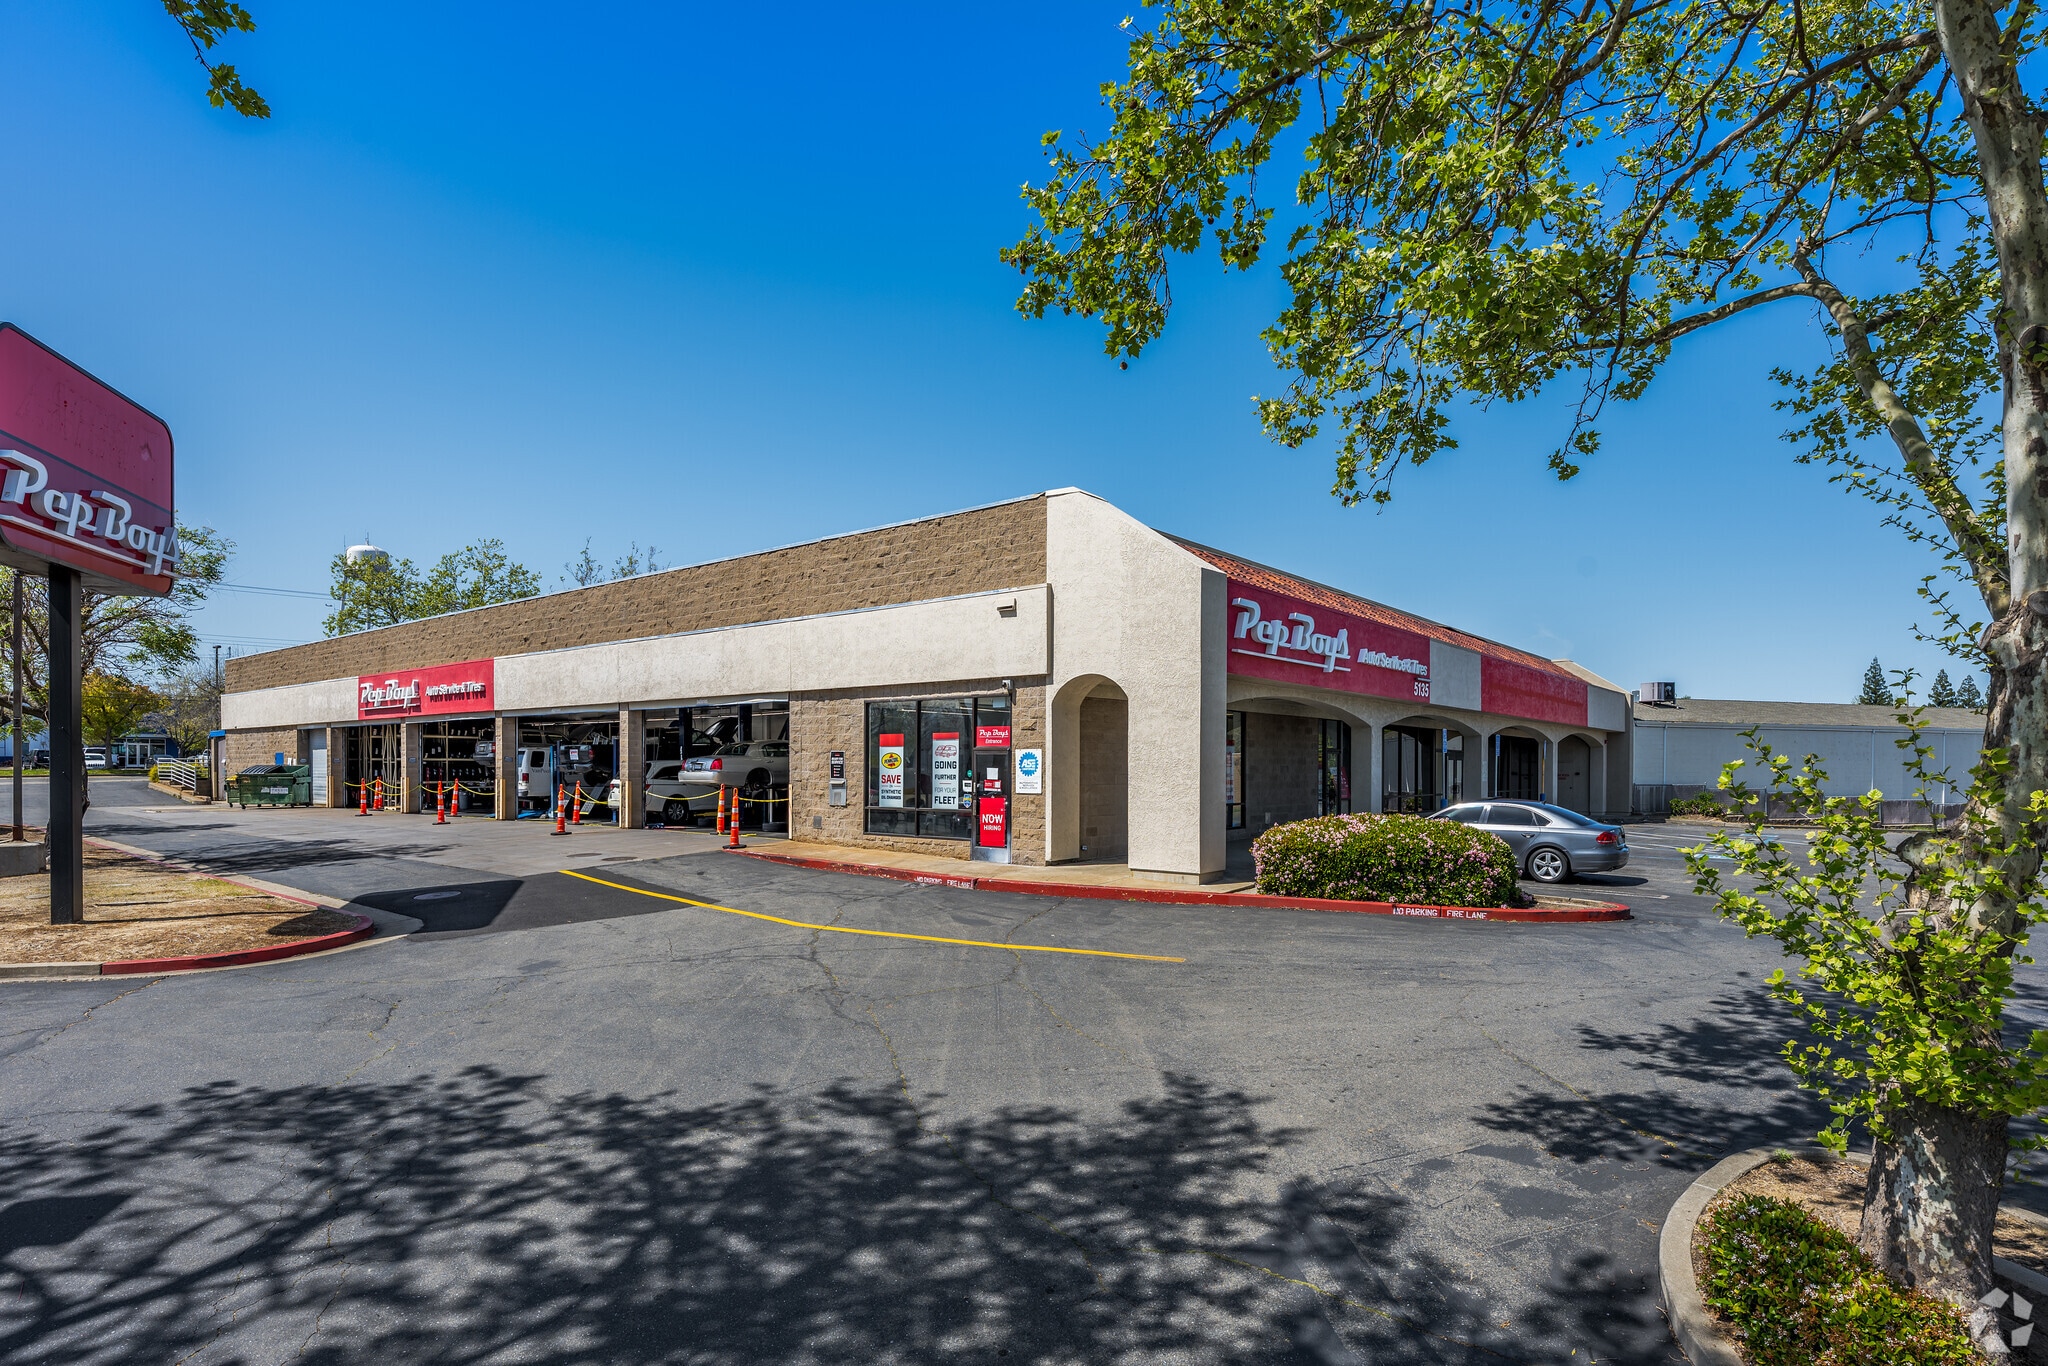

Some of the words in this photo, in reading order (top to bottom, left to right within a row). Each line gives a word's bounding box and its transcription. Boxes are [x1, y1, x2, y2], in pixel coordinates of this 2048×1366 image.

[0, 450, 97, 537] Pep
[90, 490, 183, 576] Boys
[1231, 597, 1291, 655] Pep
[1288, 612, 1351, 673] Boys
[1357, 648, 1380, 667] Auto
[1379, 652, 1406, 672] Service
[1411, 660, 1428, 676] Tires
[360, 682, 386, 707] Pep
[384, 679, 420, 709] Boys
[425, 686, 439, 697] Auto
[439, 683, 460, 695] Service
[466, 681, 486, 693] Tires
[1413, 682, 1429, 697] 5135
[979, 729, 991, 738] Pep
[992, 729, 1009, 738] Boys
[934, 760, 957, 770] GOING
[1021, 758, 1036, 768] ASE
[881, 774, 902, 784] SAVE
[934, 773, 957, 781] FURTHER
[934, 786, 944, 794] FOR
[944, 786, 957, 794] YOUR
[934, 795, 957, 805] FLEET
[982, 814, 1003, 824] NOW
[983, 824, 1002, 832] HIRING
[1393, 907, 1404, 915] NO
[1405, 908, 1438, 917] PARKING
[1446, 909, 1464, 917] FIRE
[1465, 910, 1488, 920] LANE
